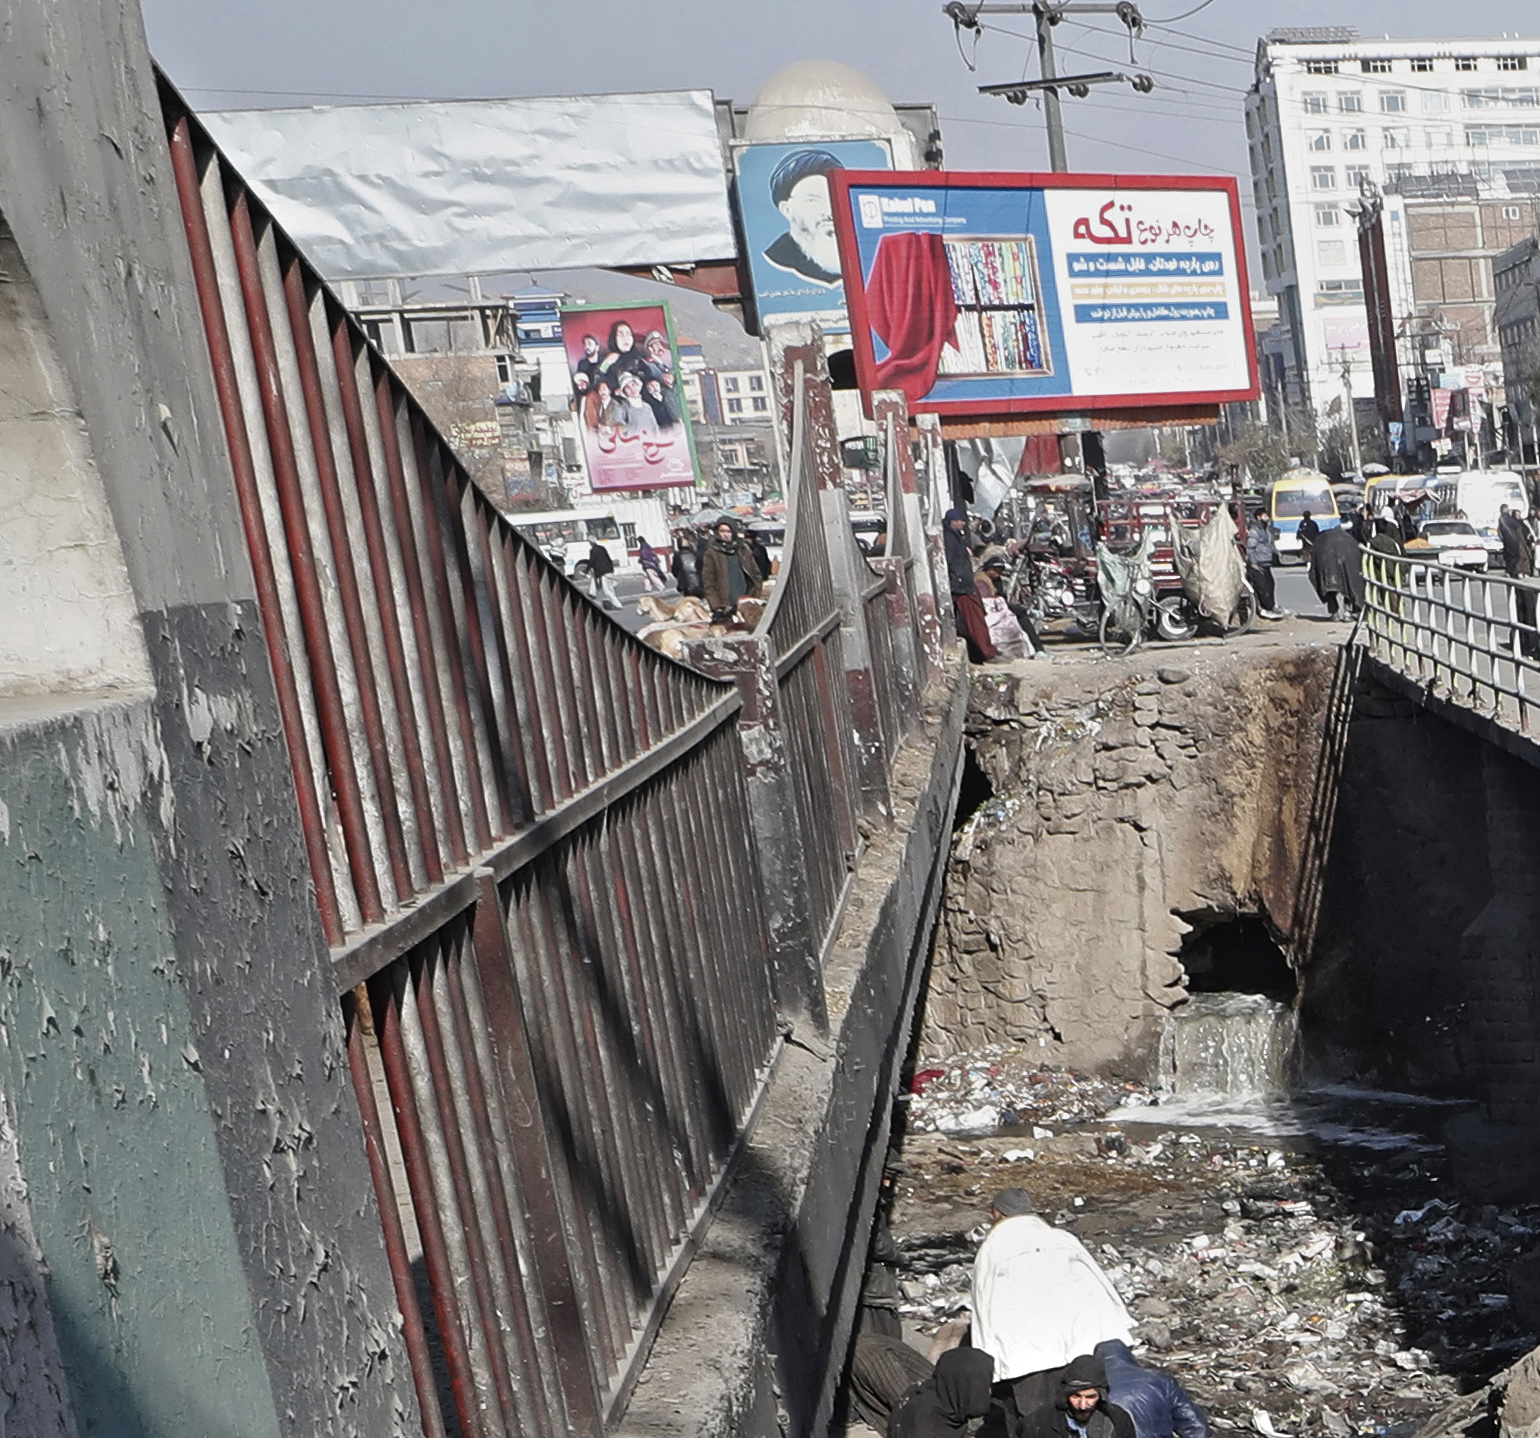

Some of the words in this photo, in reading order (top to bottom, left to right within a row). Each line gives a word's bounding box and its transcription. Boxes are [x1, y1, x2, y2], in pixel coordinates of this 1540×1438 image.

[1073, 200, 1133, 245] تکه
[1137, 219, 1161, 245] نوع
[1165, 220, 1181, 245] هر
[1183, 218, 1214, 247] چاپ
